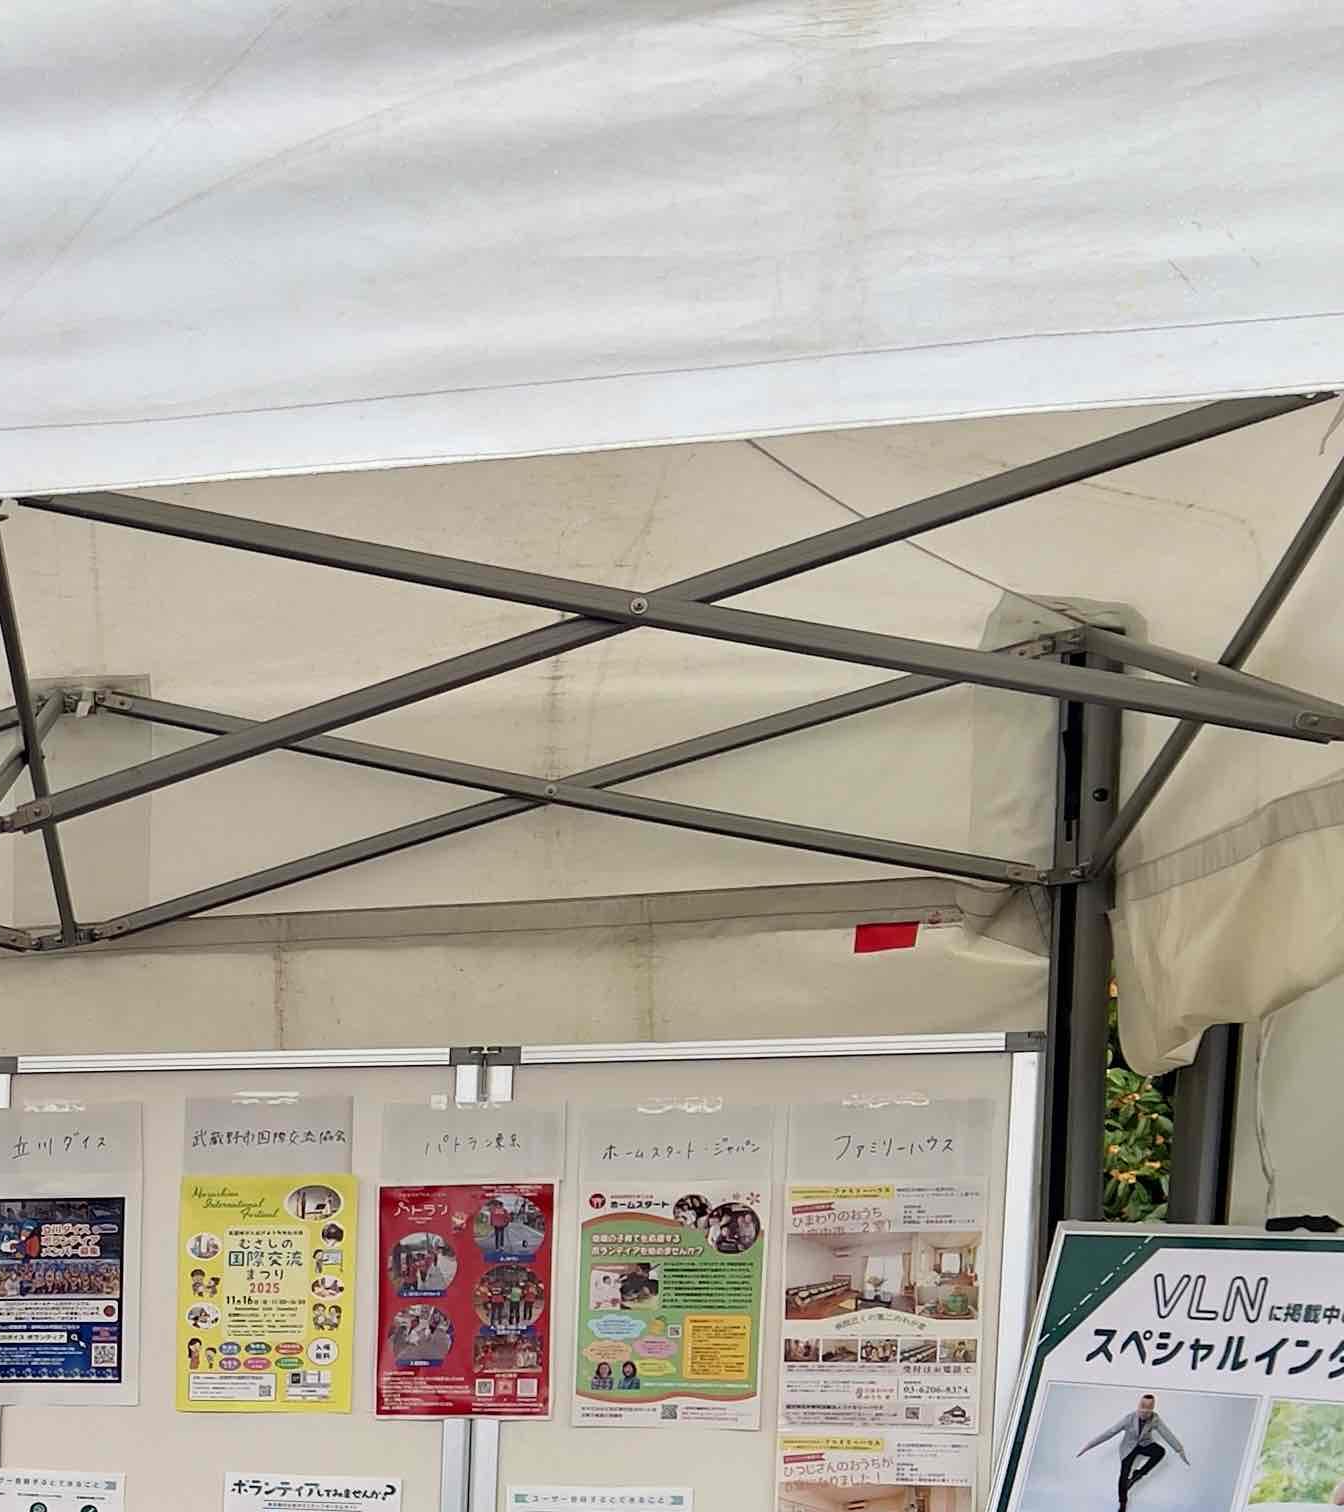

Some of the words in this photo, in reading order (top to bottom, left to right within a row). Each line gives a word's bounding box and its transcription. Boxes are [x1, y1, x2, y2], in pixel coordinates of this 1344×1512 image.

[834, 1135, 954, 1161] ファミリーハウス
[239, 1238, 294, 1250] むさしの
[228, 1250, 304, 1267] 国際交流
[245, 1269, 285, 1281] まつり
[249, 1282, 281, 1294] 2025
[231, 1479, 397, 1501] ボランティアしてみませんか？
